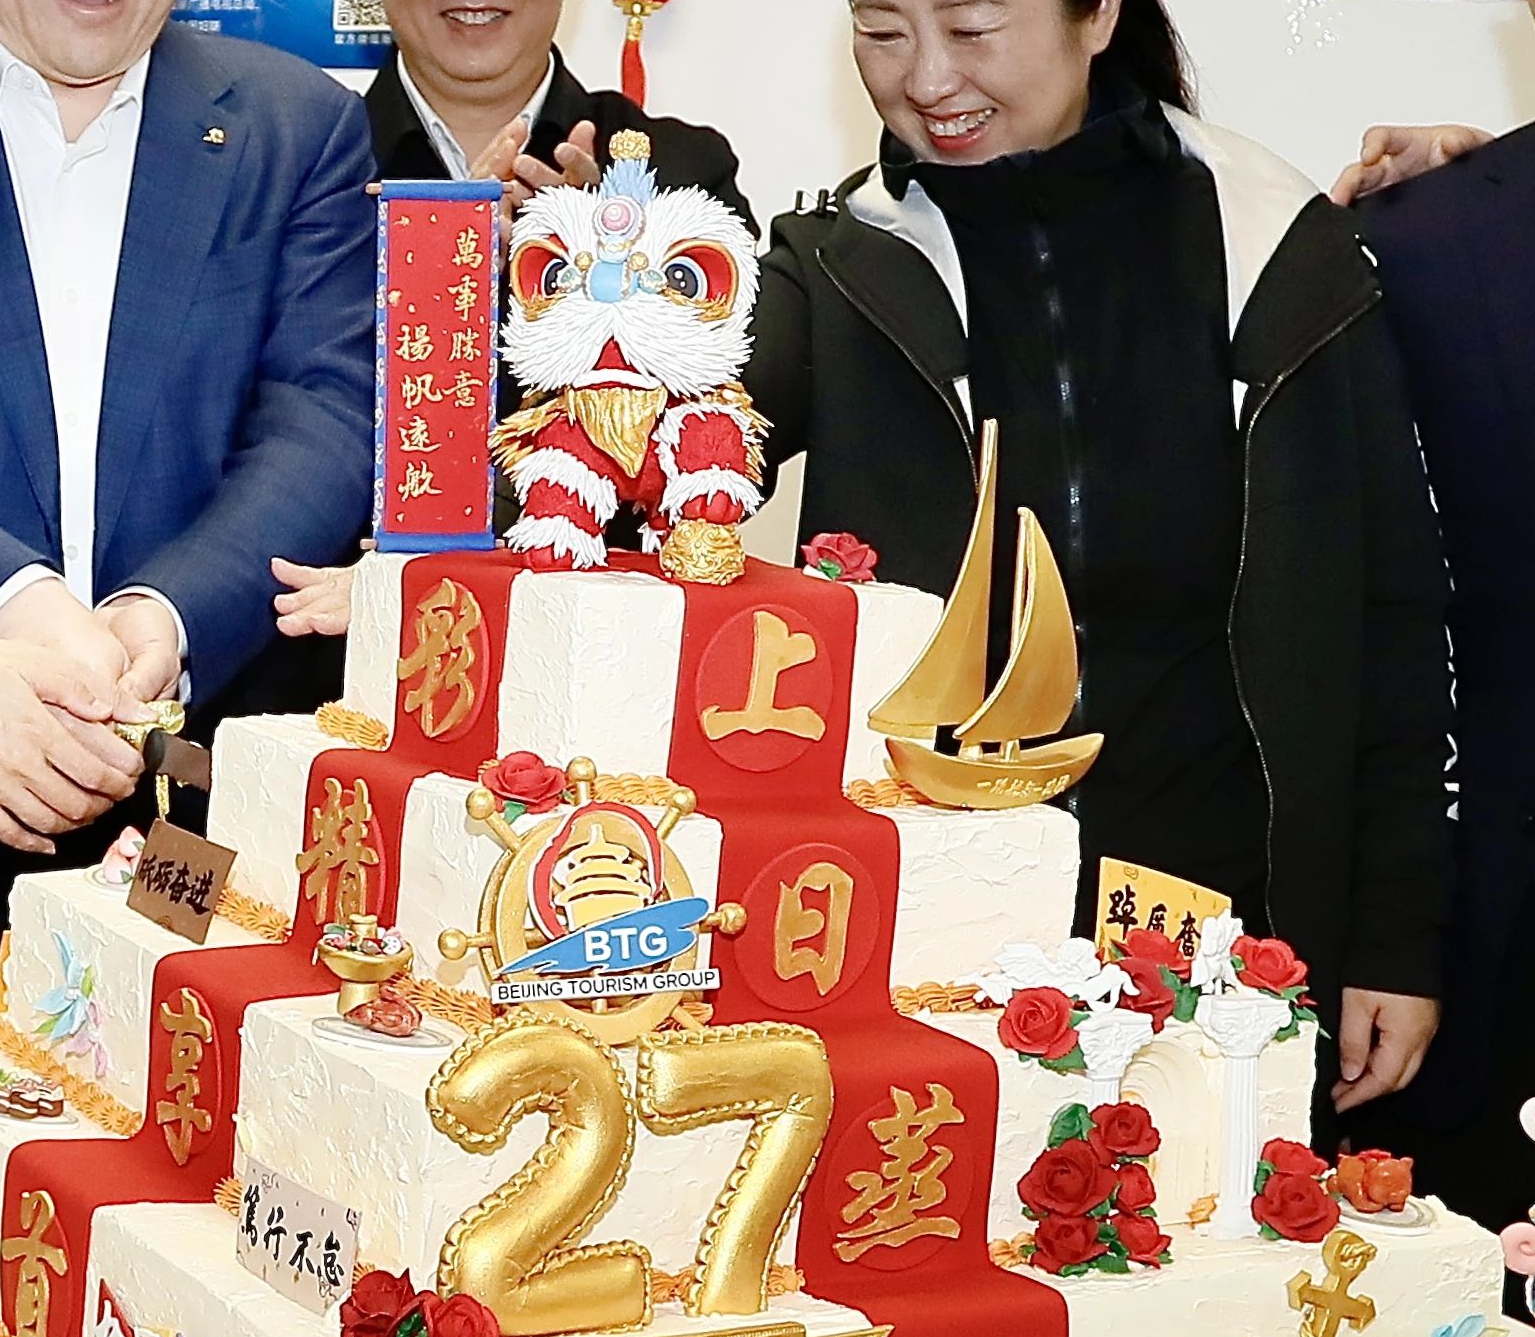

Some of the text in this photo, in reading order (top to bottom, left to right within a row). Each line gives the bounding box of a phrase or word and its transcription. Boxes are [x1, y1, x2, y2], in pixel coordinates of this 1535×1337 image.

[584, 926, 668, 962] BTG
[498, 971, 716, 1000] BEIJING TOURISM GROUP
[427, 1013, 834, 1337] 27
